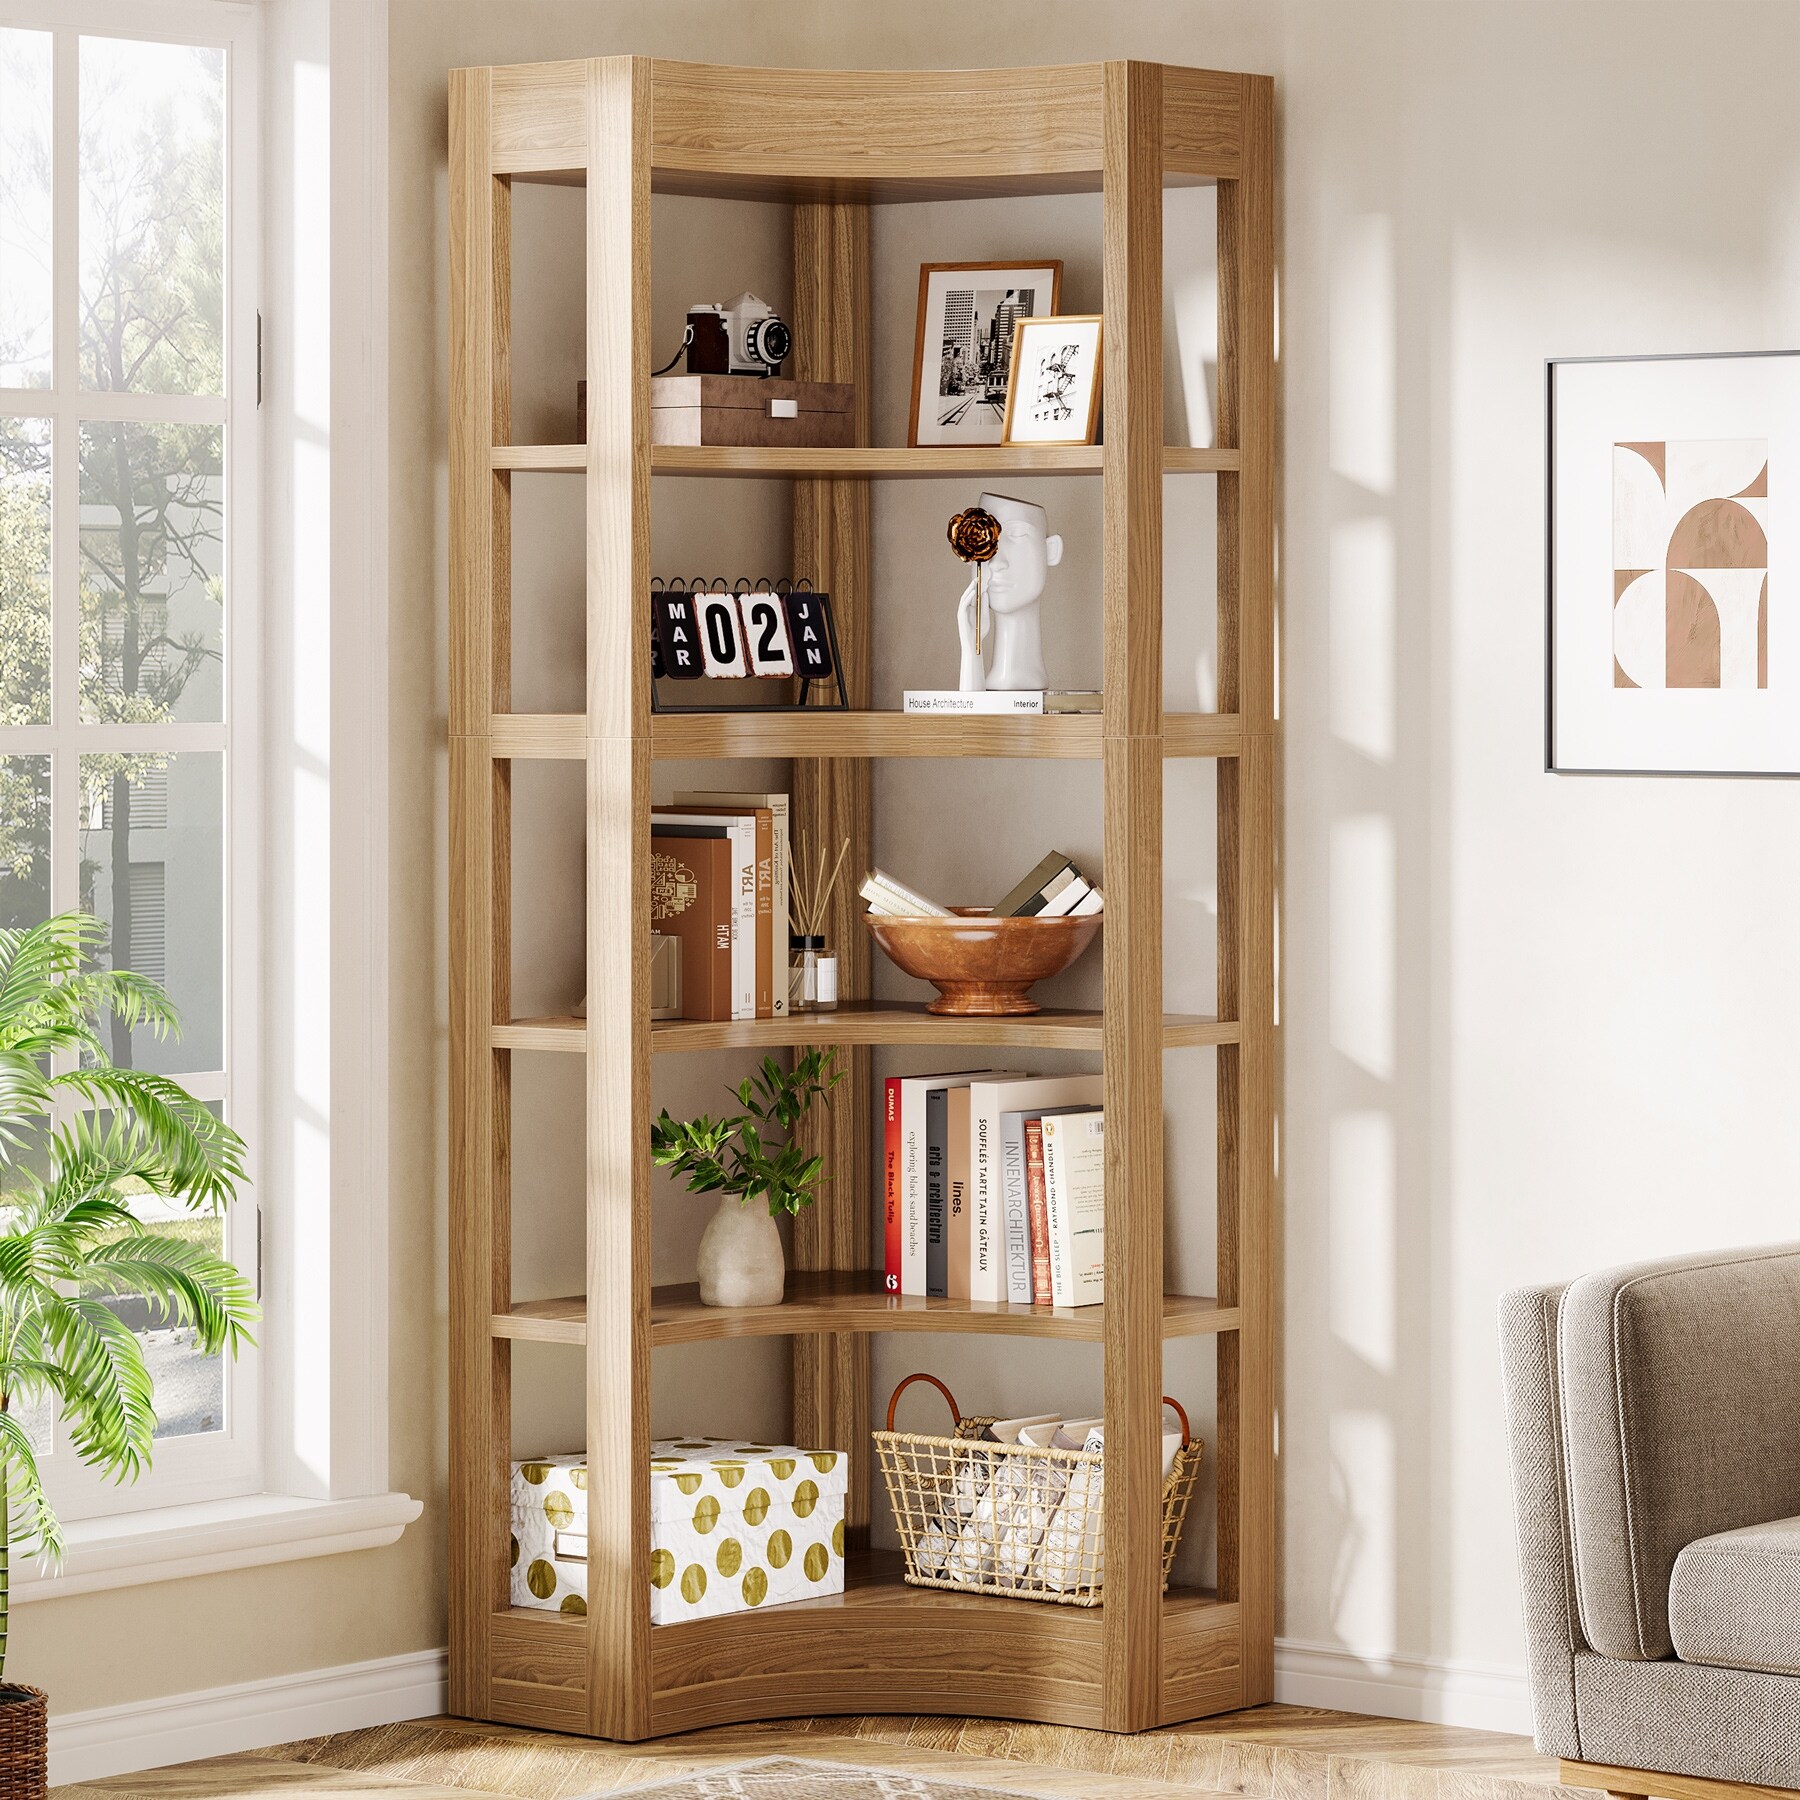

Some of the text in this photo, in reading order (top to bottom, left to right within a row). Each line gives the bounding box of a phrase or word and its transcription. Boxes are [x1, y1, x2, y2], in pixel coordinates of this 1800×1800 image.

[668, 603, 692, 666] MAR
[798, 603, 822, 664] JAN
[908, 698, 974, 709] House Architecture
[1013, 699, 1039, 709] Interior
[930, 1146, 942, 1166] arts
[1047, 1143, 1056, 1184] CHANDLER
[887, 1200, 895, 1224] Tulip
[908, 1131, 919, 1256] exploring black sand beaches
[930, 1182, 943, 1244] architecture
[952, 1182, 964, 1217] lines.
[979, 1118, 990, 1272] SOUFFLÉS TARTE TATIN GÂTEAUX
[1049, 1188, 1058, 1228] RAYMOND
[1005, 1142, 1026, 1290] INNENARCHITEKTUR
